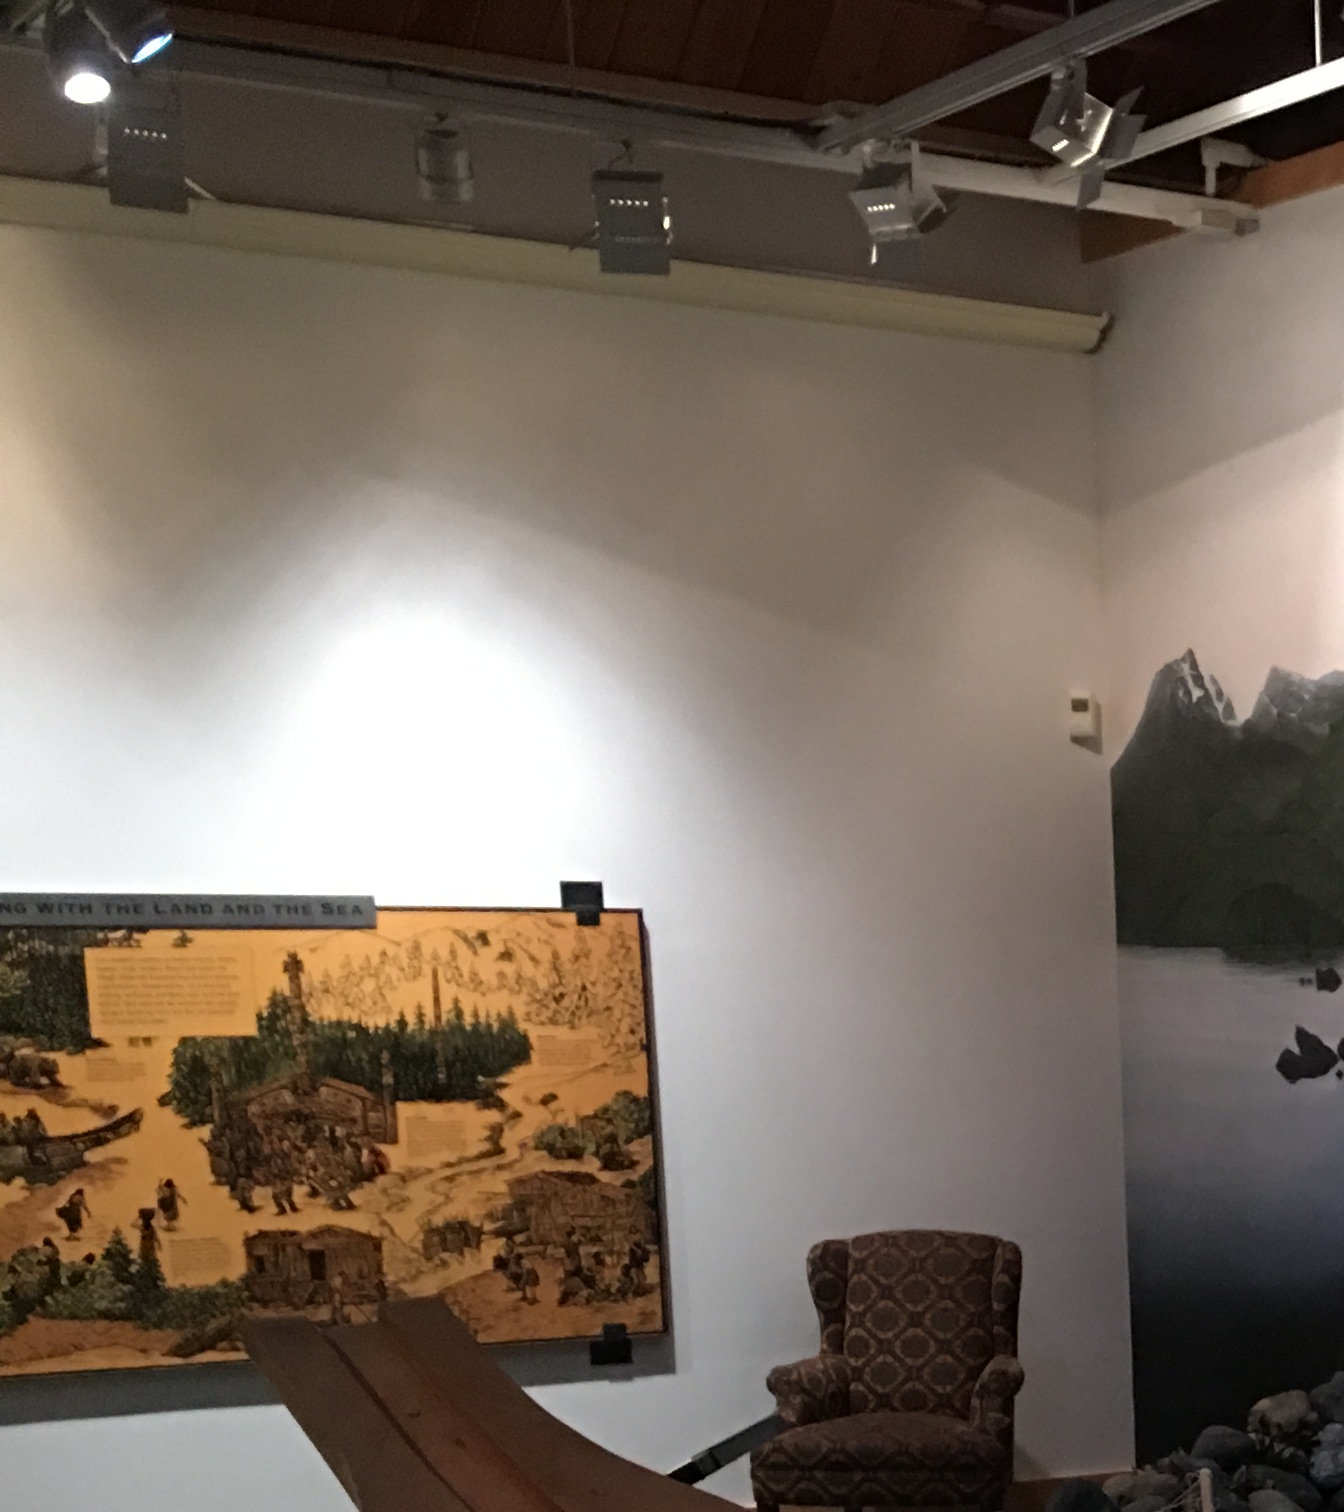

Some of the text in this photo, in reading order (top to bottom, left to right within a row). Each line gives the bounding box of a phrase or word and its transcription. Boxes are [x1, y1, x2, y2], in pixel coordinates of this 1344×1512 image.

[37, 902, 93, 916] WITH
[102, 902, 144, 916] THE
[154, 901, 213, 916] LAND
[221, 903, 266, 917] AND
[274, 903, 312, 917] THE
[321, 903, 364, 917] SEA
